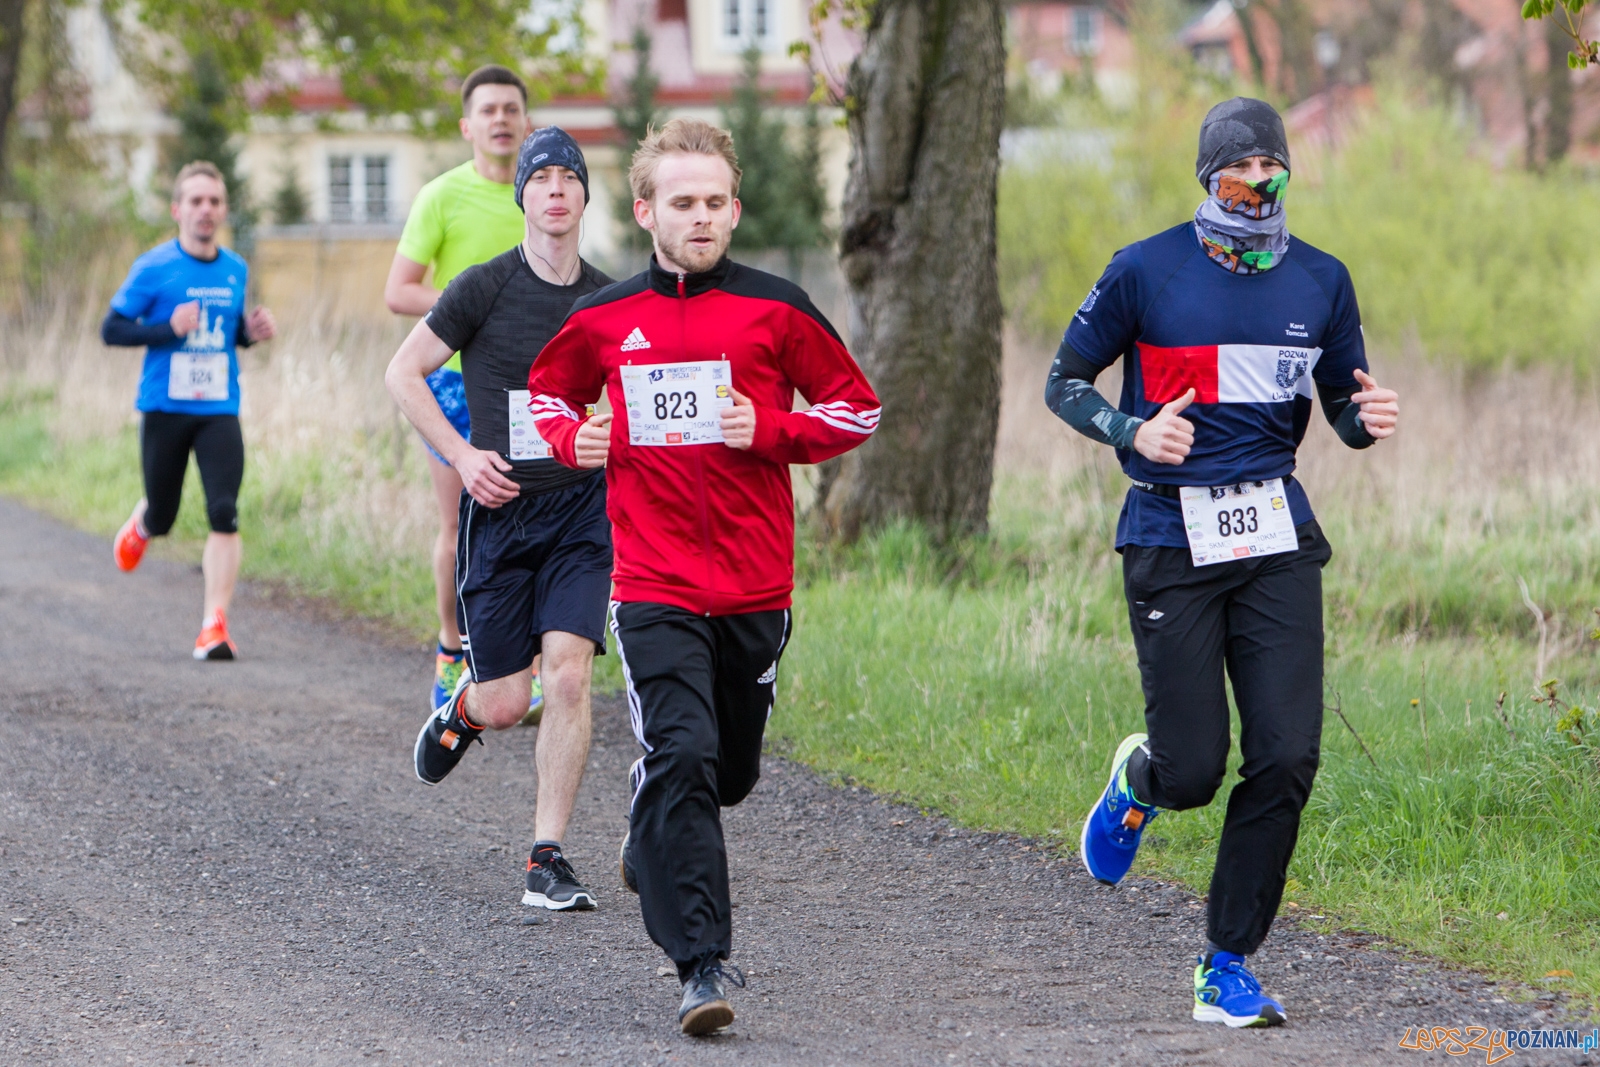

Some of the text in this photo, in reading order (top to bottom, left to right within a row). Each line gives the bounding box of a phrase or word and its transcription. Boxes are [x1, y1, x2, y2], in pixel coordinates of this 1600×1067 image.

[1290, 322, 1305, 331] Karol
[1285, 330, 1309, 338] Tomczak
[654, 391, 698, 420] 823
[693, 420, 714, 429] 10KM
[1217, 506, 1259, 537] 833
[1209, 541, 1224, 549] 5KM
[1256, 531, 1277, 542] 10KM
